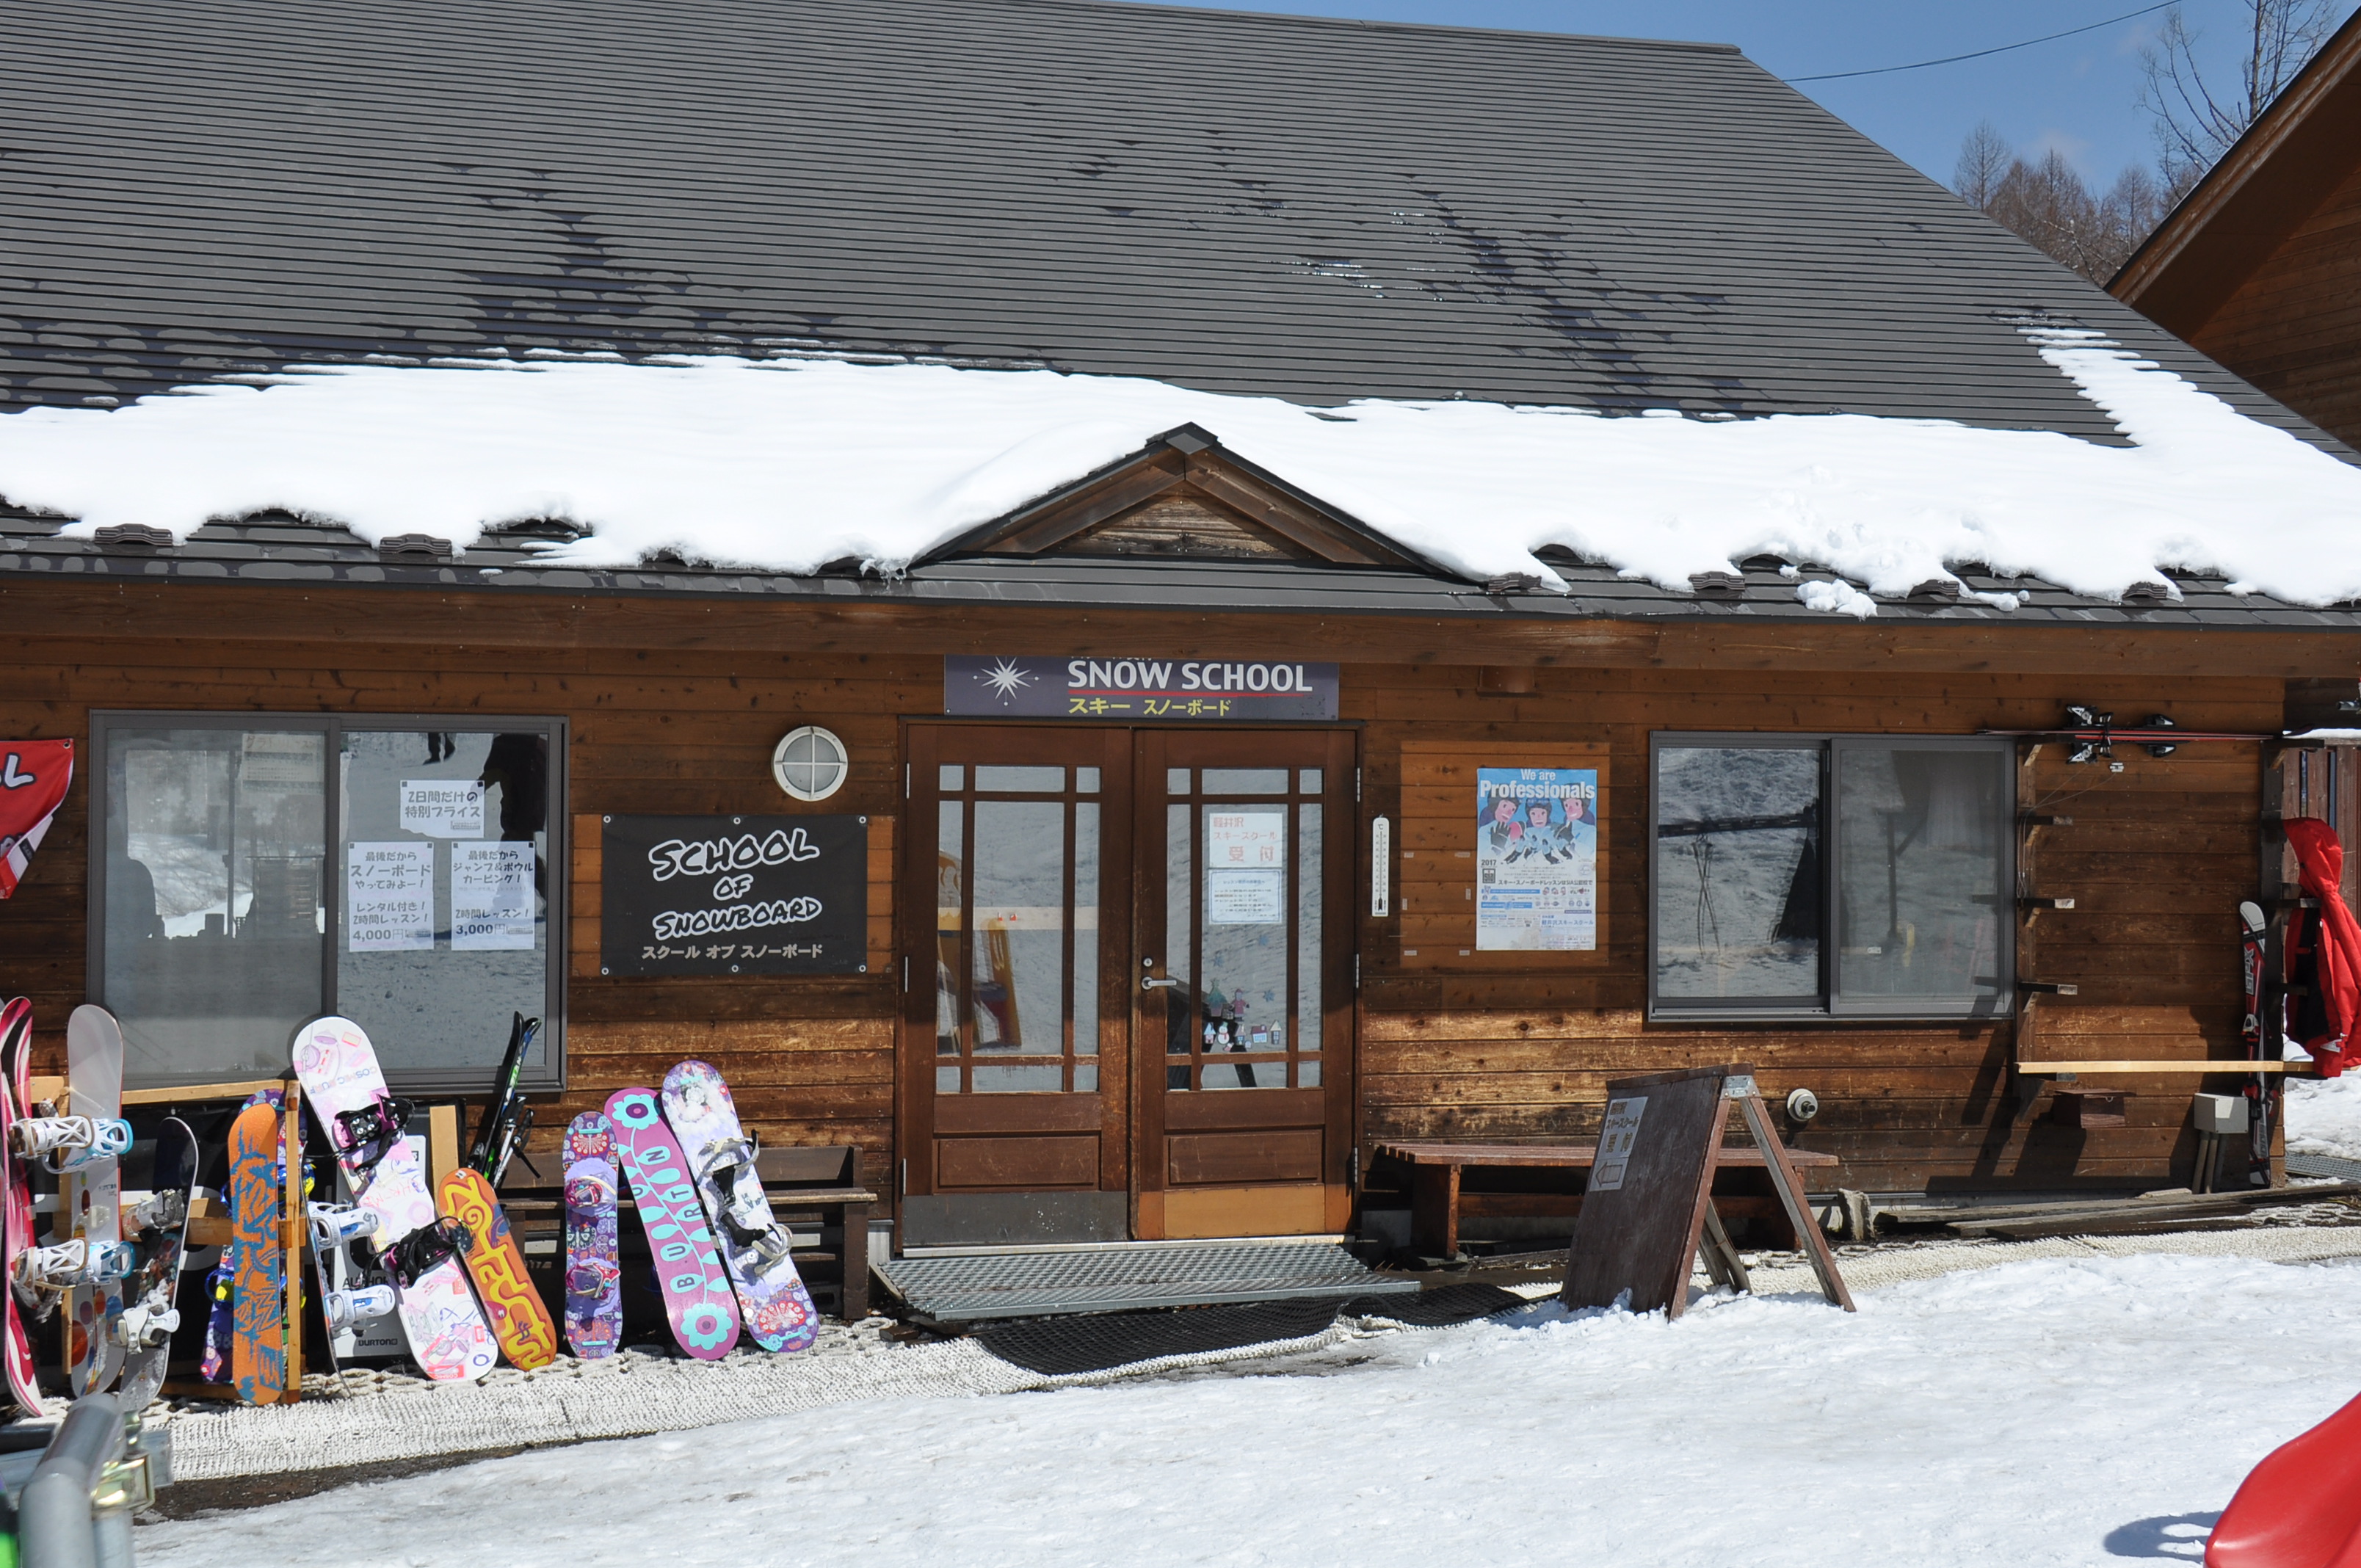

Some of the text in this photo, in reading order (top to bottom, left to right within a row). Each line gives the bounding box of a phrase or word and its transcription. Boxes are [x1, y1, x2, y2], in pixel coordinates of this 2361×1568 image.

[1068, 660, 1313, 692] SNOW SCHOOL
[1069, 697, 1231, 716] スキー スノーボード
[1520, 769, 1556, 781] We are
[1480, 780, 1595, 799] Professionals
[408, 791, 478, 803] 2日間だけの
[1214, 817, 1244, 827] 軽井沢
[1214, 831, 1277, 840] スキースクール
[366, 852, 417, 861] 最後だから
[468, 851, 518, 860] 最後だから
[648, 827, 820, 882] SCHOOL
[351, 864, 431, 876] スノーボード
[713, 874, 754, 901] OF
[652, 896, 822, 940] SNOWBOARD
[353, 929, 404, 942] 4,000円
[456, 923, 505, 936] 3,000円
[642, 943, 822, 959] スクール オブ スノーボード
[343, 1276, 388, 1288] AUHO
